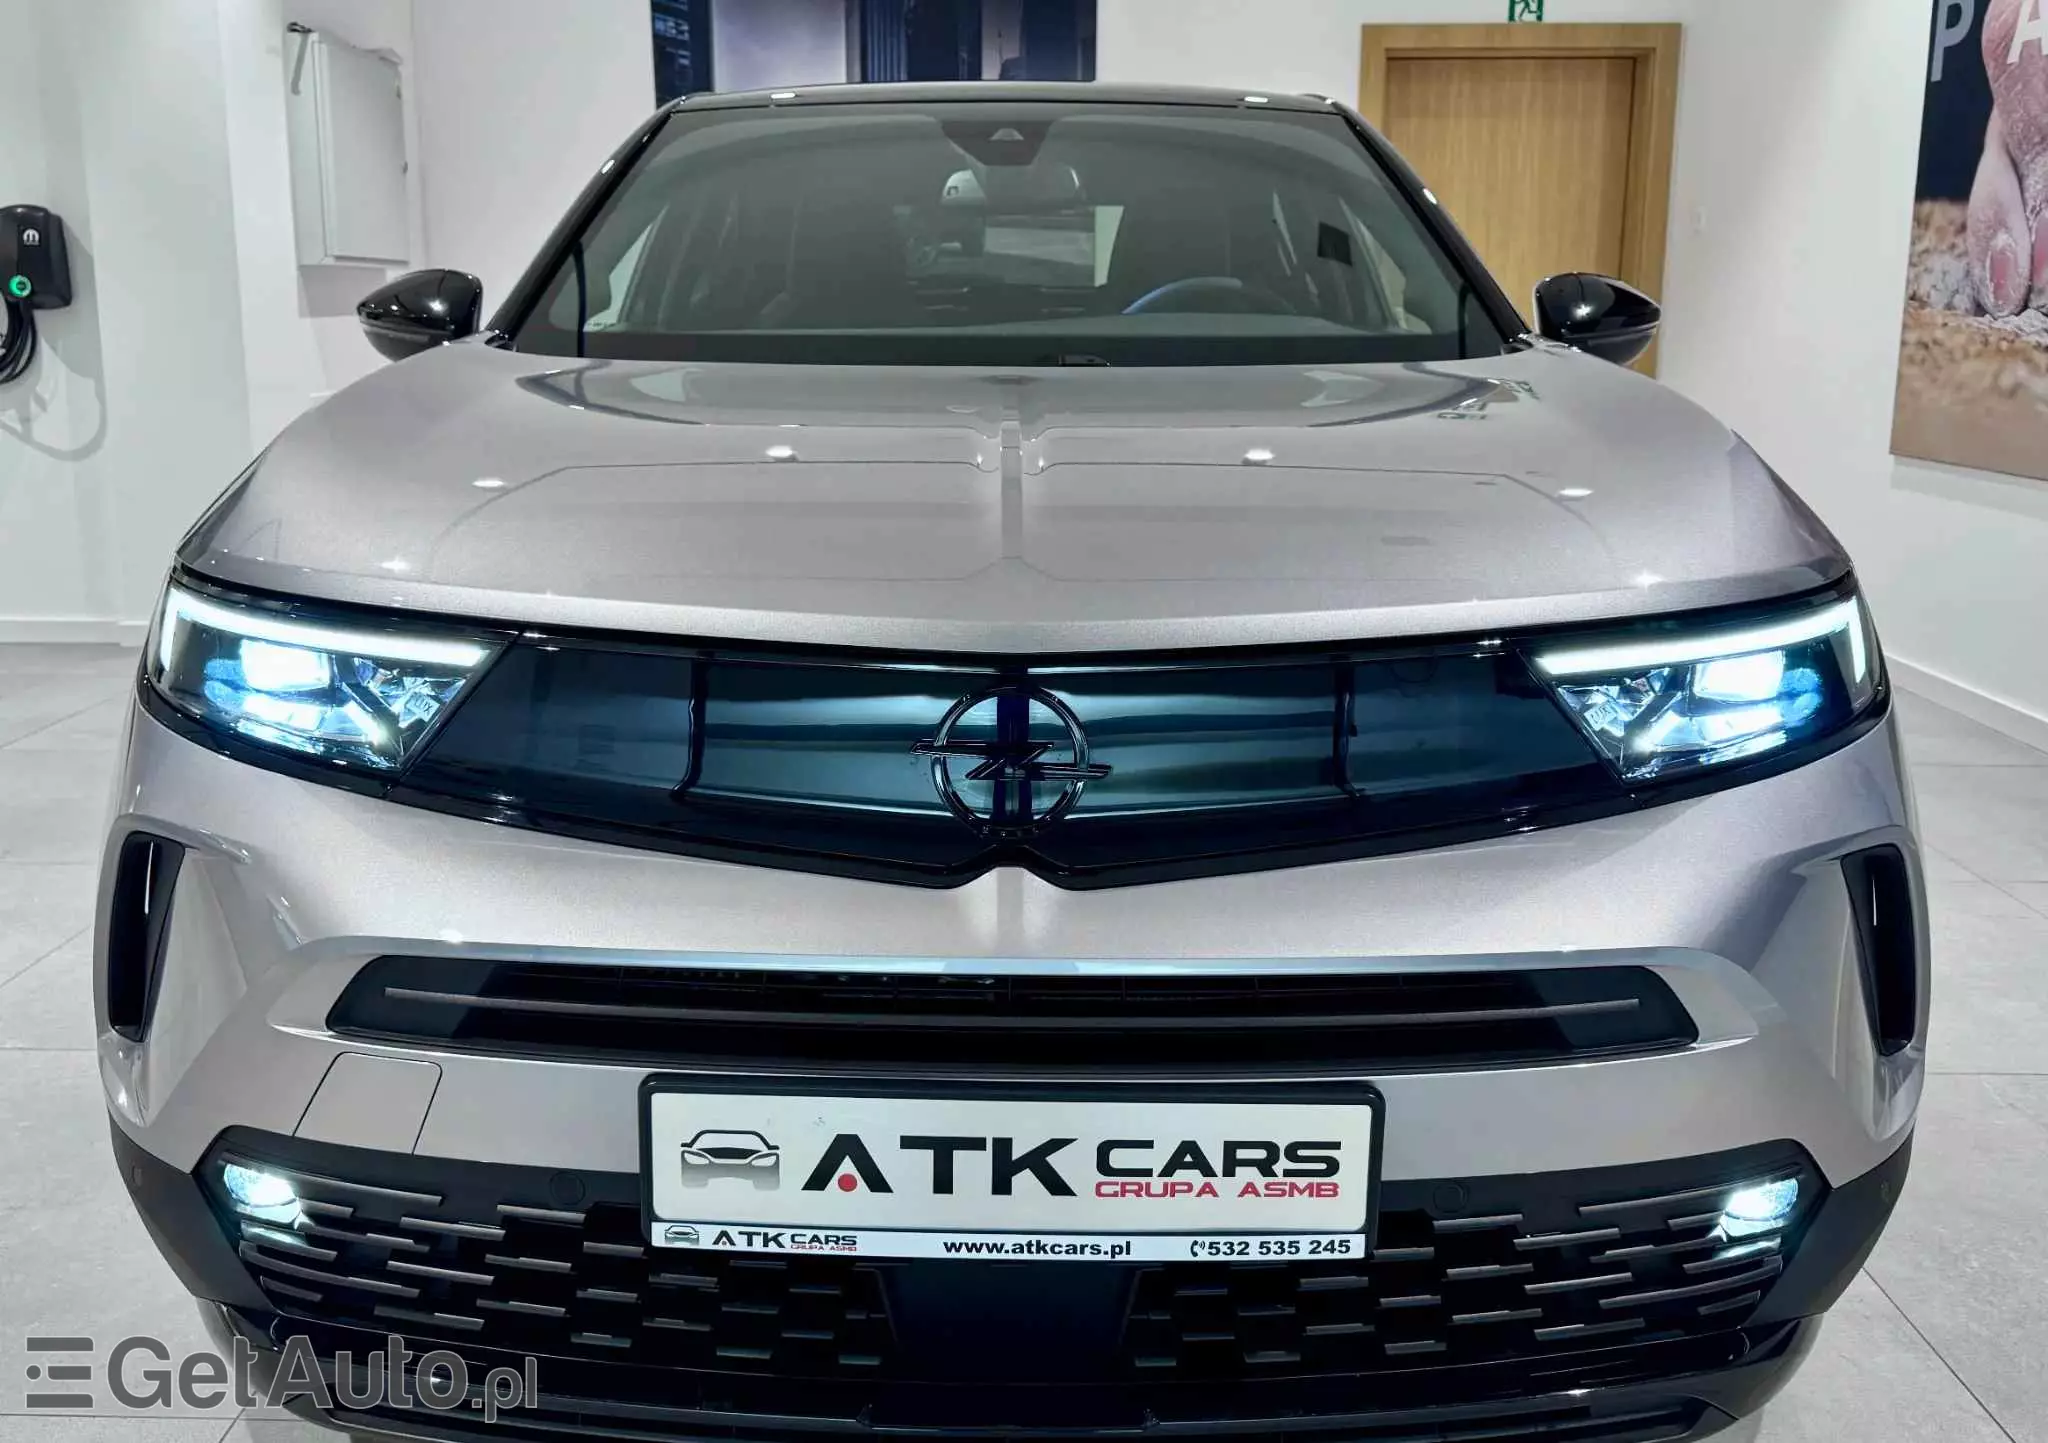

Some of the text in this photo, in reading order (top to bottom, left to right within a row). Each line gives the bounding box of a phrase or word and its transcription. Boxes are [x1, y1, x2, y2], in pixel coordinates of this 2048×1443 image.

[801, 1133, 1342, 1197] ATK CARS
[1095, 1181, 1340, 1198] GRUPA ASMB
[712, 1230, 858, 1248] ATK CARS
[1207, 1239, 1351, 1256] 532 535 245
[943, 1239, 1132, 1259] www.atkcars.pl
